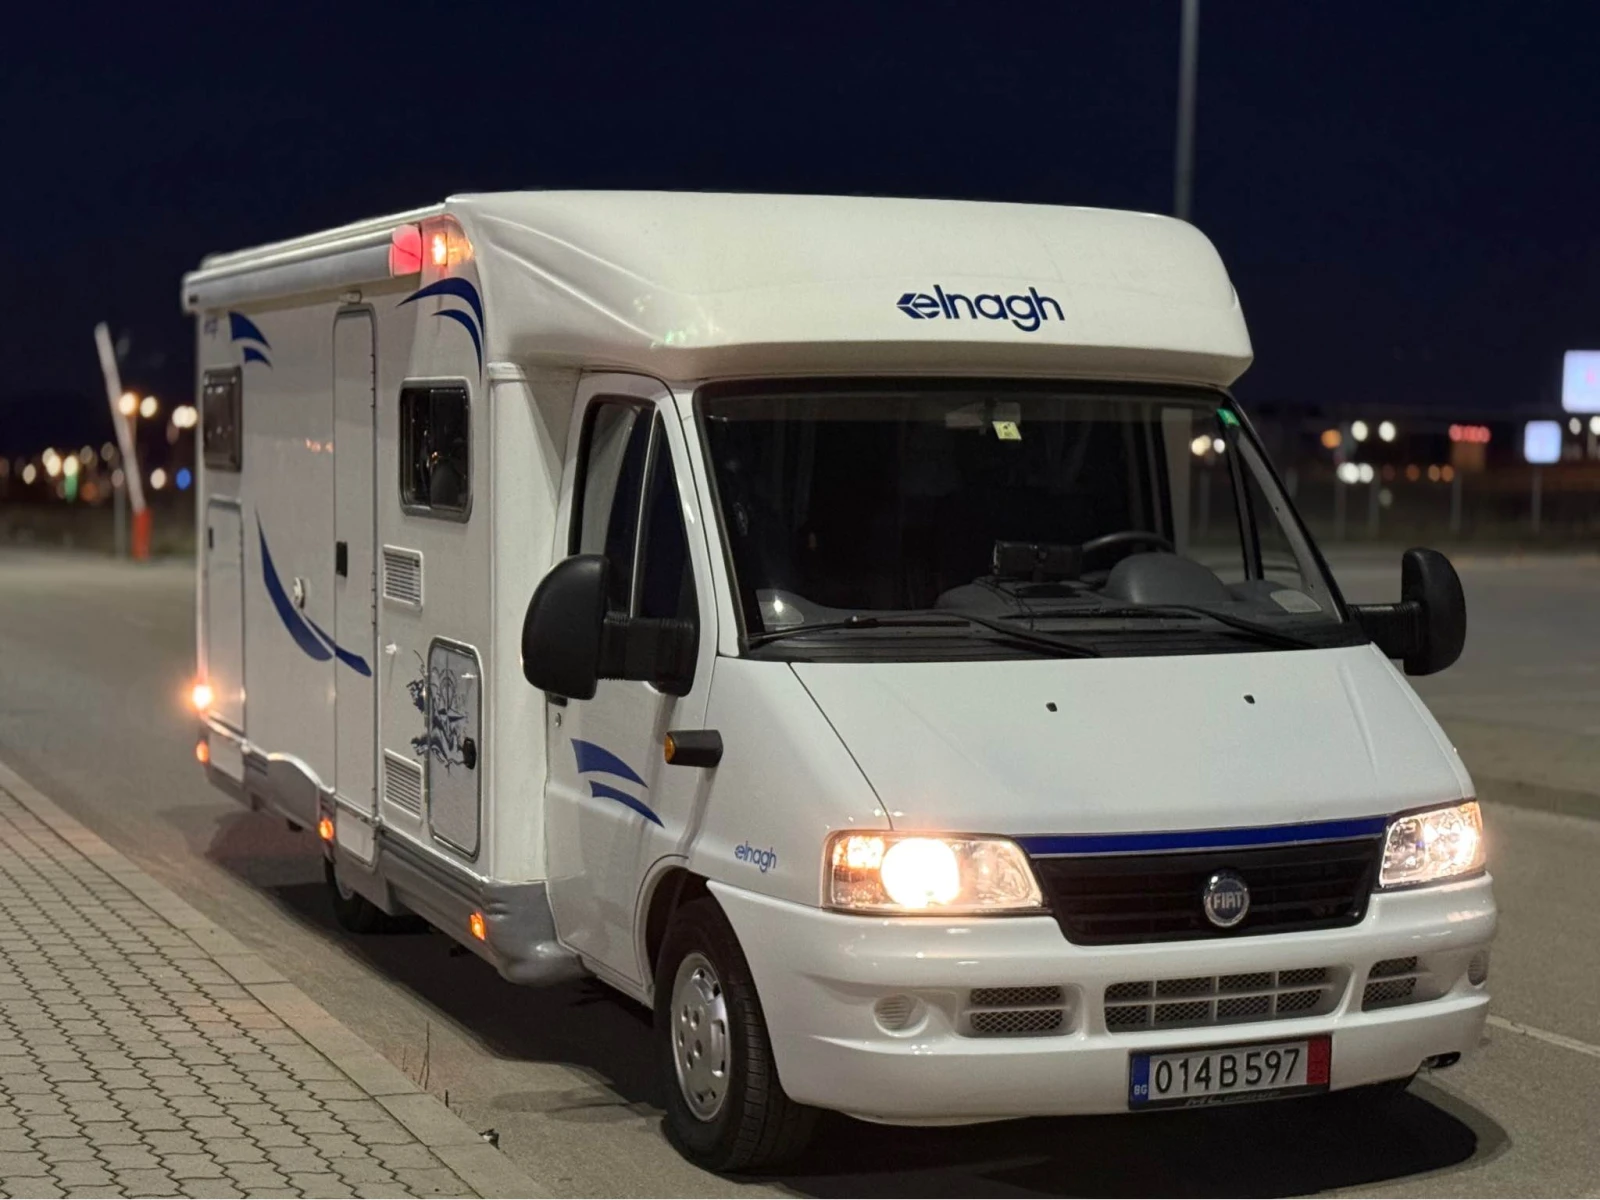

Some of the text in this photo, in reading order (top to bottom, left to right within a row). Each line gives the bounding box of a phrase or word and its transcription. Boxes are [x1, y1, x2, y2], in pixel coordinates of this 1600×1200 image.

[897, 284, 1066, 332] elnagh
[734, 840, 777, 873] elnagh
[1213, 892, 1242, 909] FIAT
[1154, 1048, 1300, 1094] 014B597
[1134, 1084, 1148, 1096] BG
